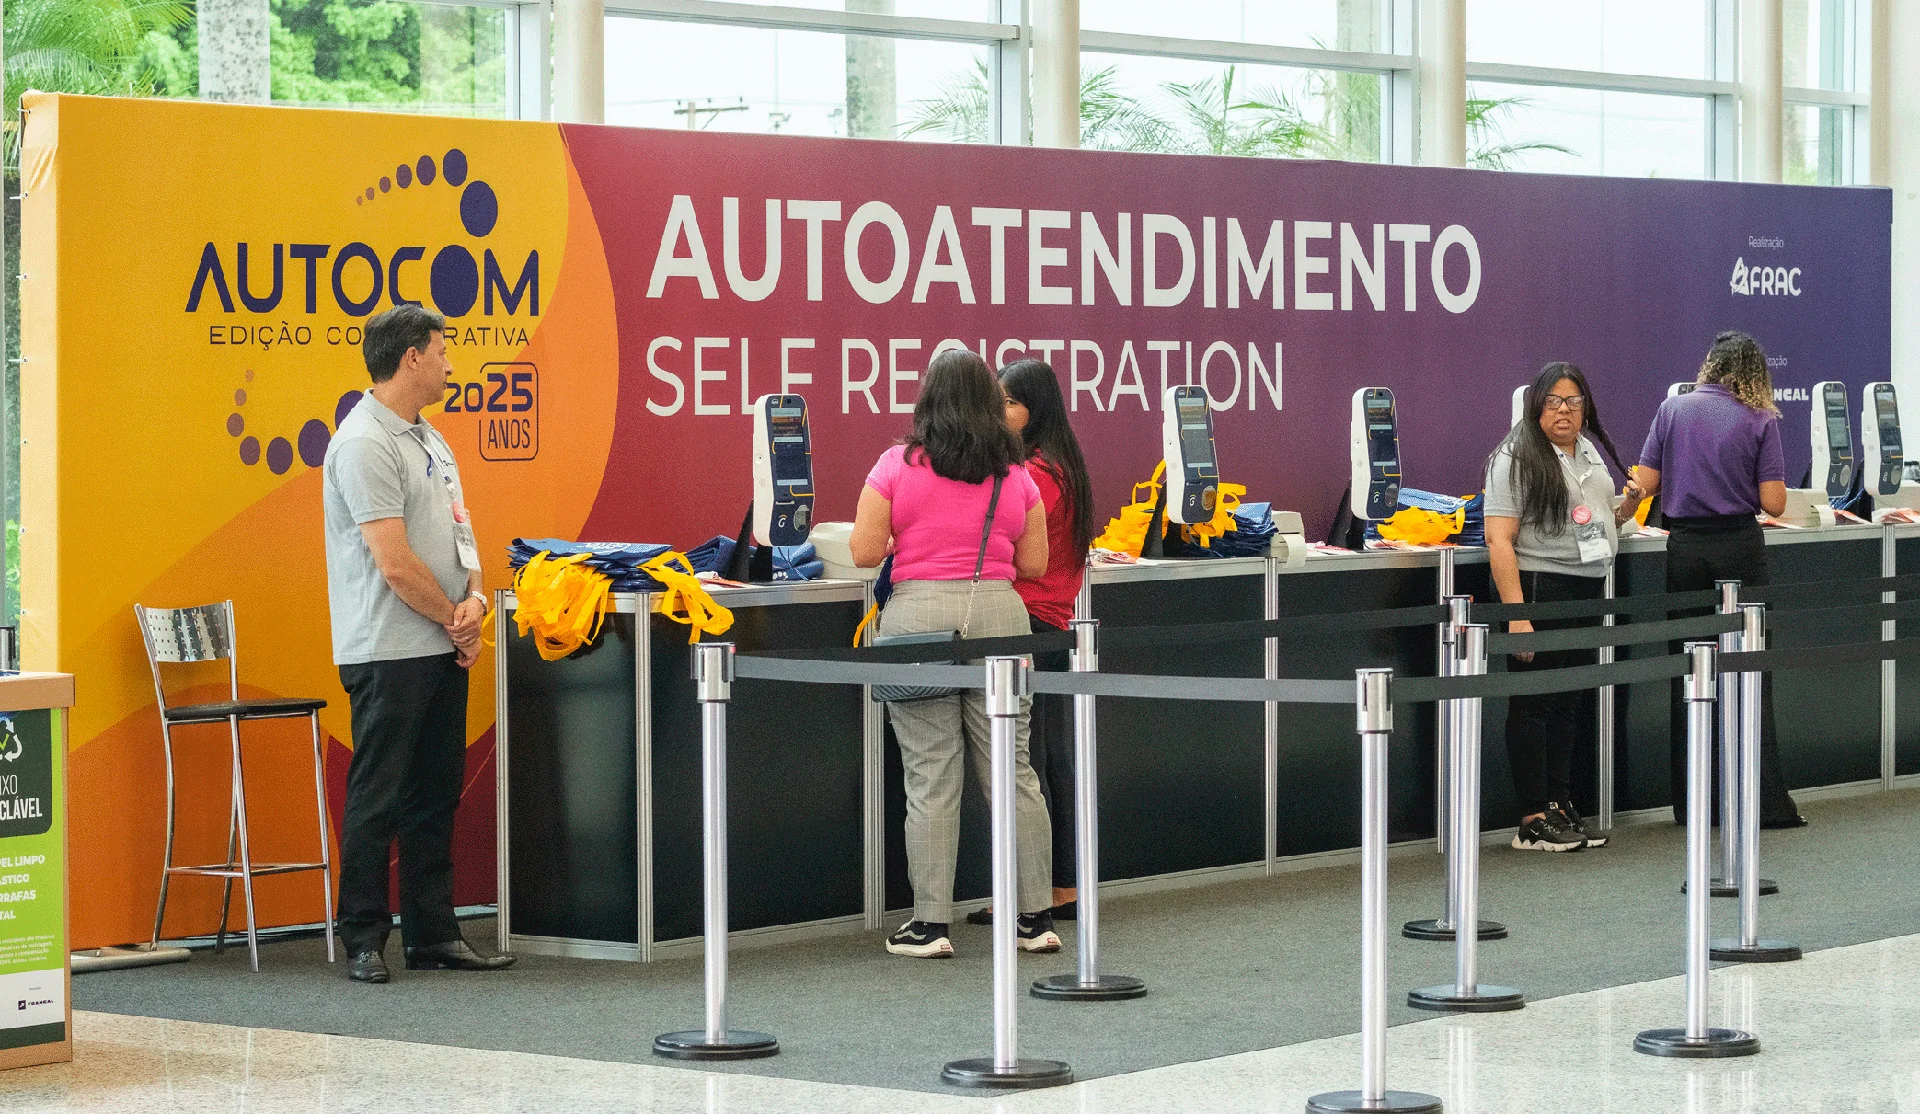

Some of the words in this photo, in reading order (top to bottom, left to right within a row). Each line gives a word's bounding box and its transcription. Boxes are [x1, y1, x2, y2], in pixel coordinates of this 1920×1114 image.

[646, 194, 1482, 314] AUTOATENDIMENTO
[1748, 235, 1785, 251] Realização
[185, 241, 540, 318] AUTOCOM
[209, 320, 312, 351] EDIÇÃO
[326, 326, 530, 346] CORATIVA
[645, 335, 816, 417] SELF
[840, 338, 1284, 414] RETRATION
[487, 418, 531, 449] ANOS
[0, 774, 18, 796] IXO
[0, 795, 43, 821] CLÁVEL
[15, 854, 46, 867] LIMPO
[0, 873, 30, 886] STICO
[0, 909, 17, 921] TAL
